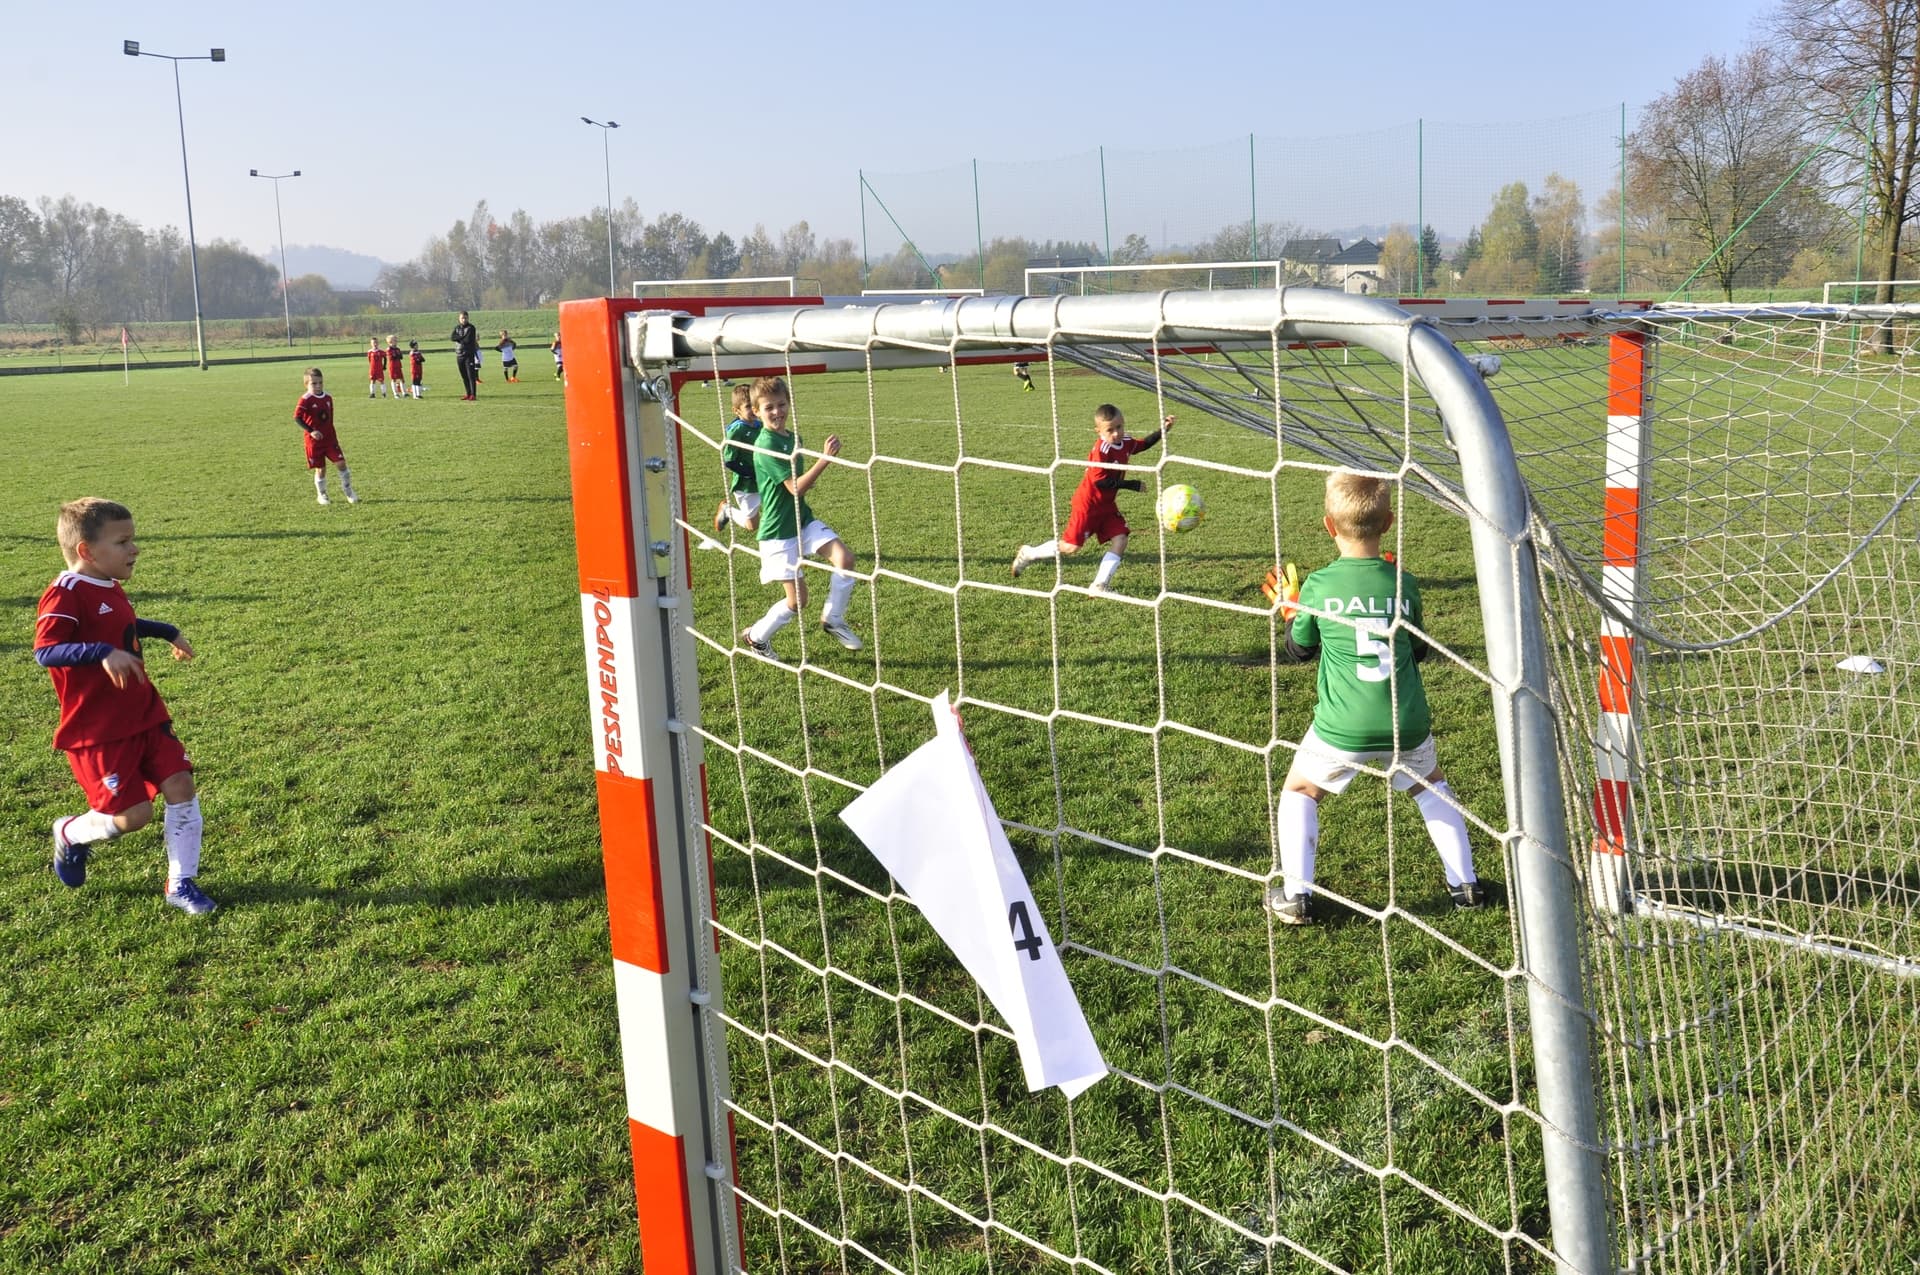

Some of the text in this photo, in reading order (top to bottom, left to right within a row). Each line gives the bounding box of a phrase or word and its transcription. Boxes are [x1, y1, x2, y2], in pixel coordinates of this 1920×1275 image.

[1324, 596, 1410, 615] DALIN
[1355, 617, 1394, 682] 5
[592, 586, 624, 778] PESMENPOL
[1008, 901, 1043, 961] 4
